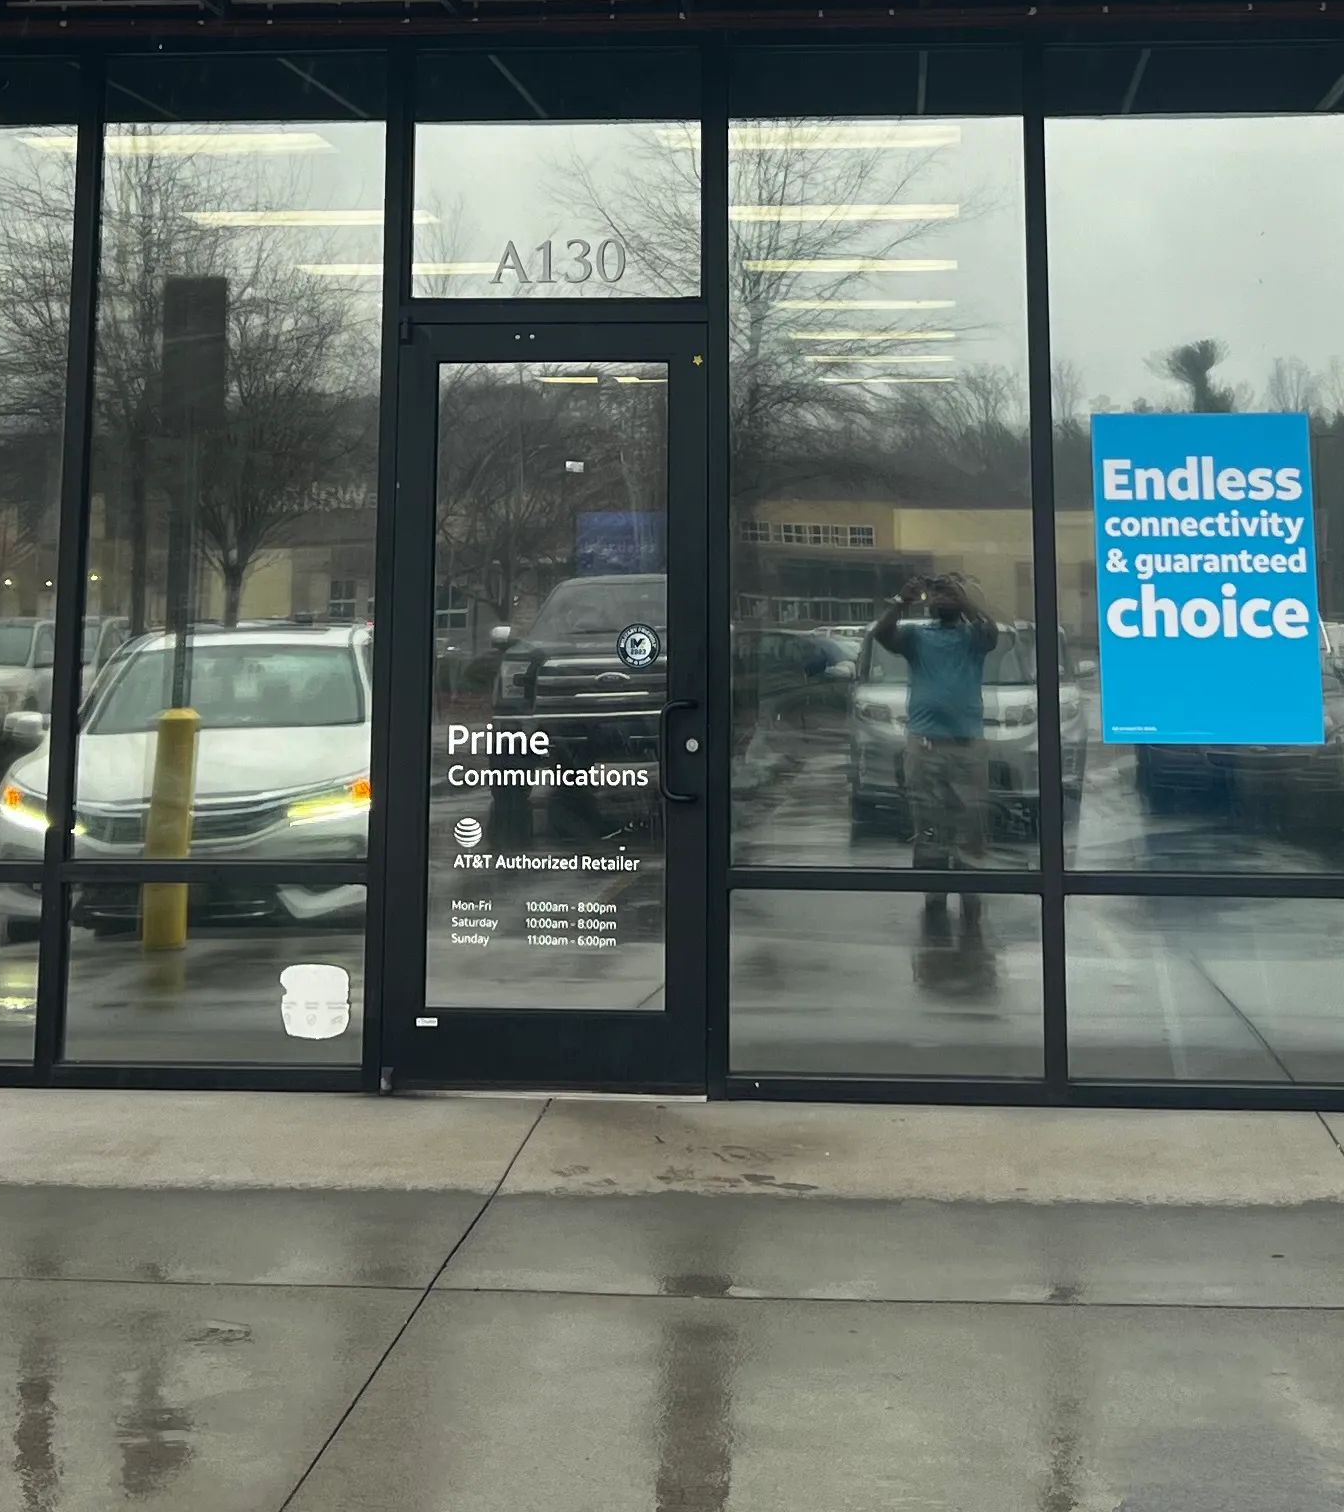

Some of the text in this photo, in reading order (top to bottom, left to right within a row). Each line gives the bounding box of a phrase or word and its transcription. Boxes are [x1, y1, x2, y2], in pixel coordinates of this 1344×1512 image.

[489, 238, 627, 285] A130
[1102, 455, 1303, 501] Endless
[1104, 509, 1305, 544] connectivity
[1105, 547, 1307, 580] & guaranteed
[1106, 582, 1310, 639] choice
[447, 723, 550, 755] Prime
[447, 764, 649, 787] Communications
[454, 854, 640, 871] AT&T Authorized Retailer
[451, 900, 493, 912] Mon-Fri
[526, 901, 569, 913] 10:00am
[577, 902, 617, 915] 8:00pm
[451, 917, 499, 931] Saturday
[525, 918, 569, 929] 10:00am
[451, 933, 490, 947] Sunday
[577, 936, 617, 949] 6:00pm
